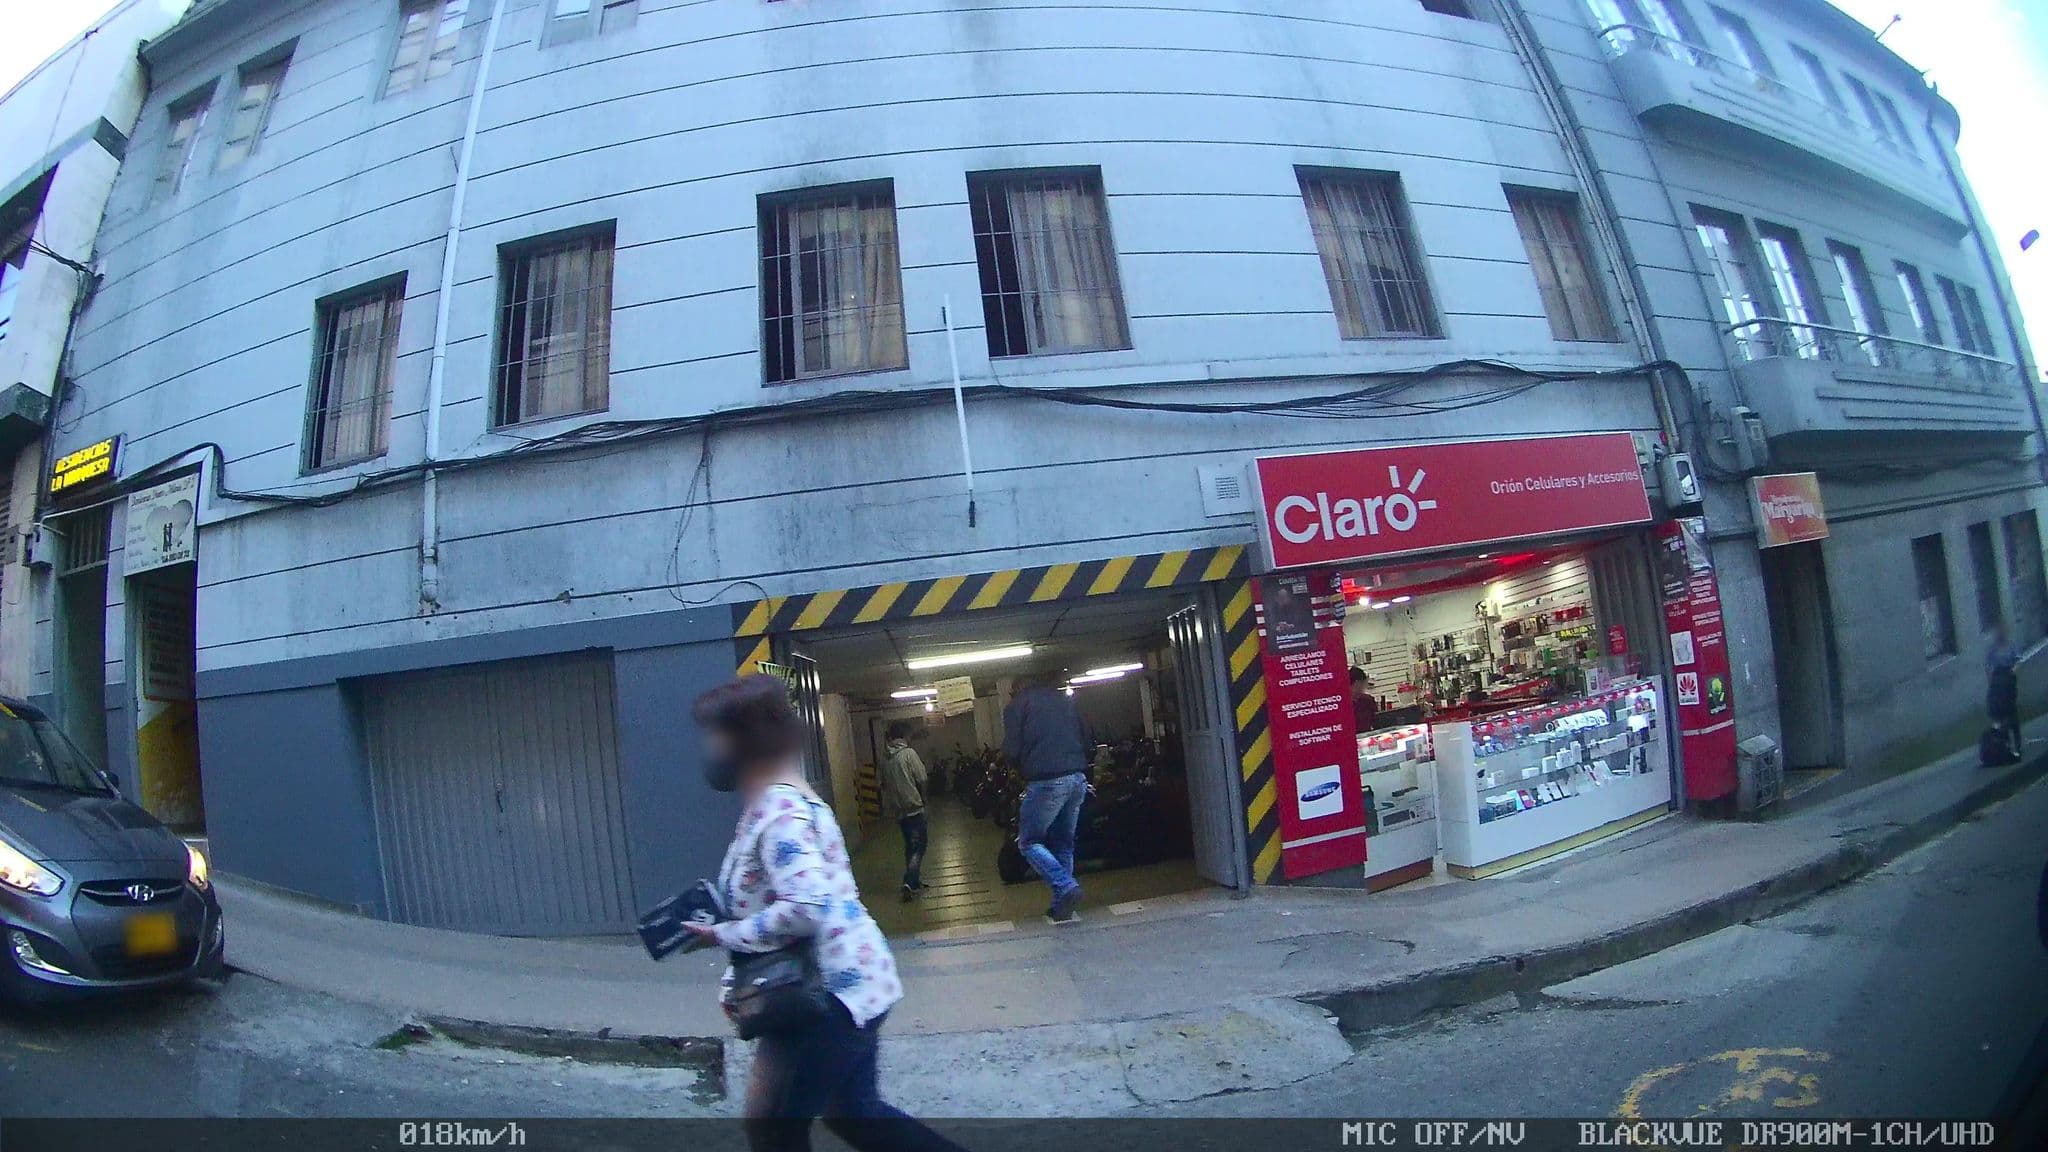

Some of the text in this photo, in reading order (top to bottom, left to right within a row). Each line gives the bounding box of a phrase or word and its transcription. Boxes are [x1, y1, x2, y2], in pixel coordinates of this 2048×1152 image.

[1490, 469, 1639, 495] Orión Celulares y Accesorios
[1274, 488, 1421, 544] Claro
[1284, 658, 1324, 670] CELULARES
[1279, 672, 1333, 687] COMPUTADORES
[1290, 667, 1320, 677] TABLETS
[1281, 695, 1342, 711] SERVICIO TECNICO
[1287, 703, 1339, 718] ESPECIALIZADO
[1289, 724, 1343, 739] INSTALACION DE
